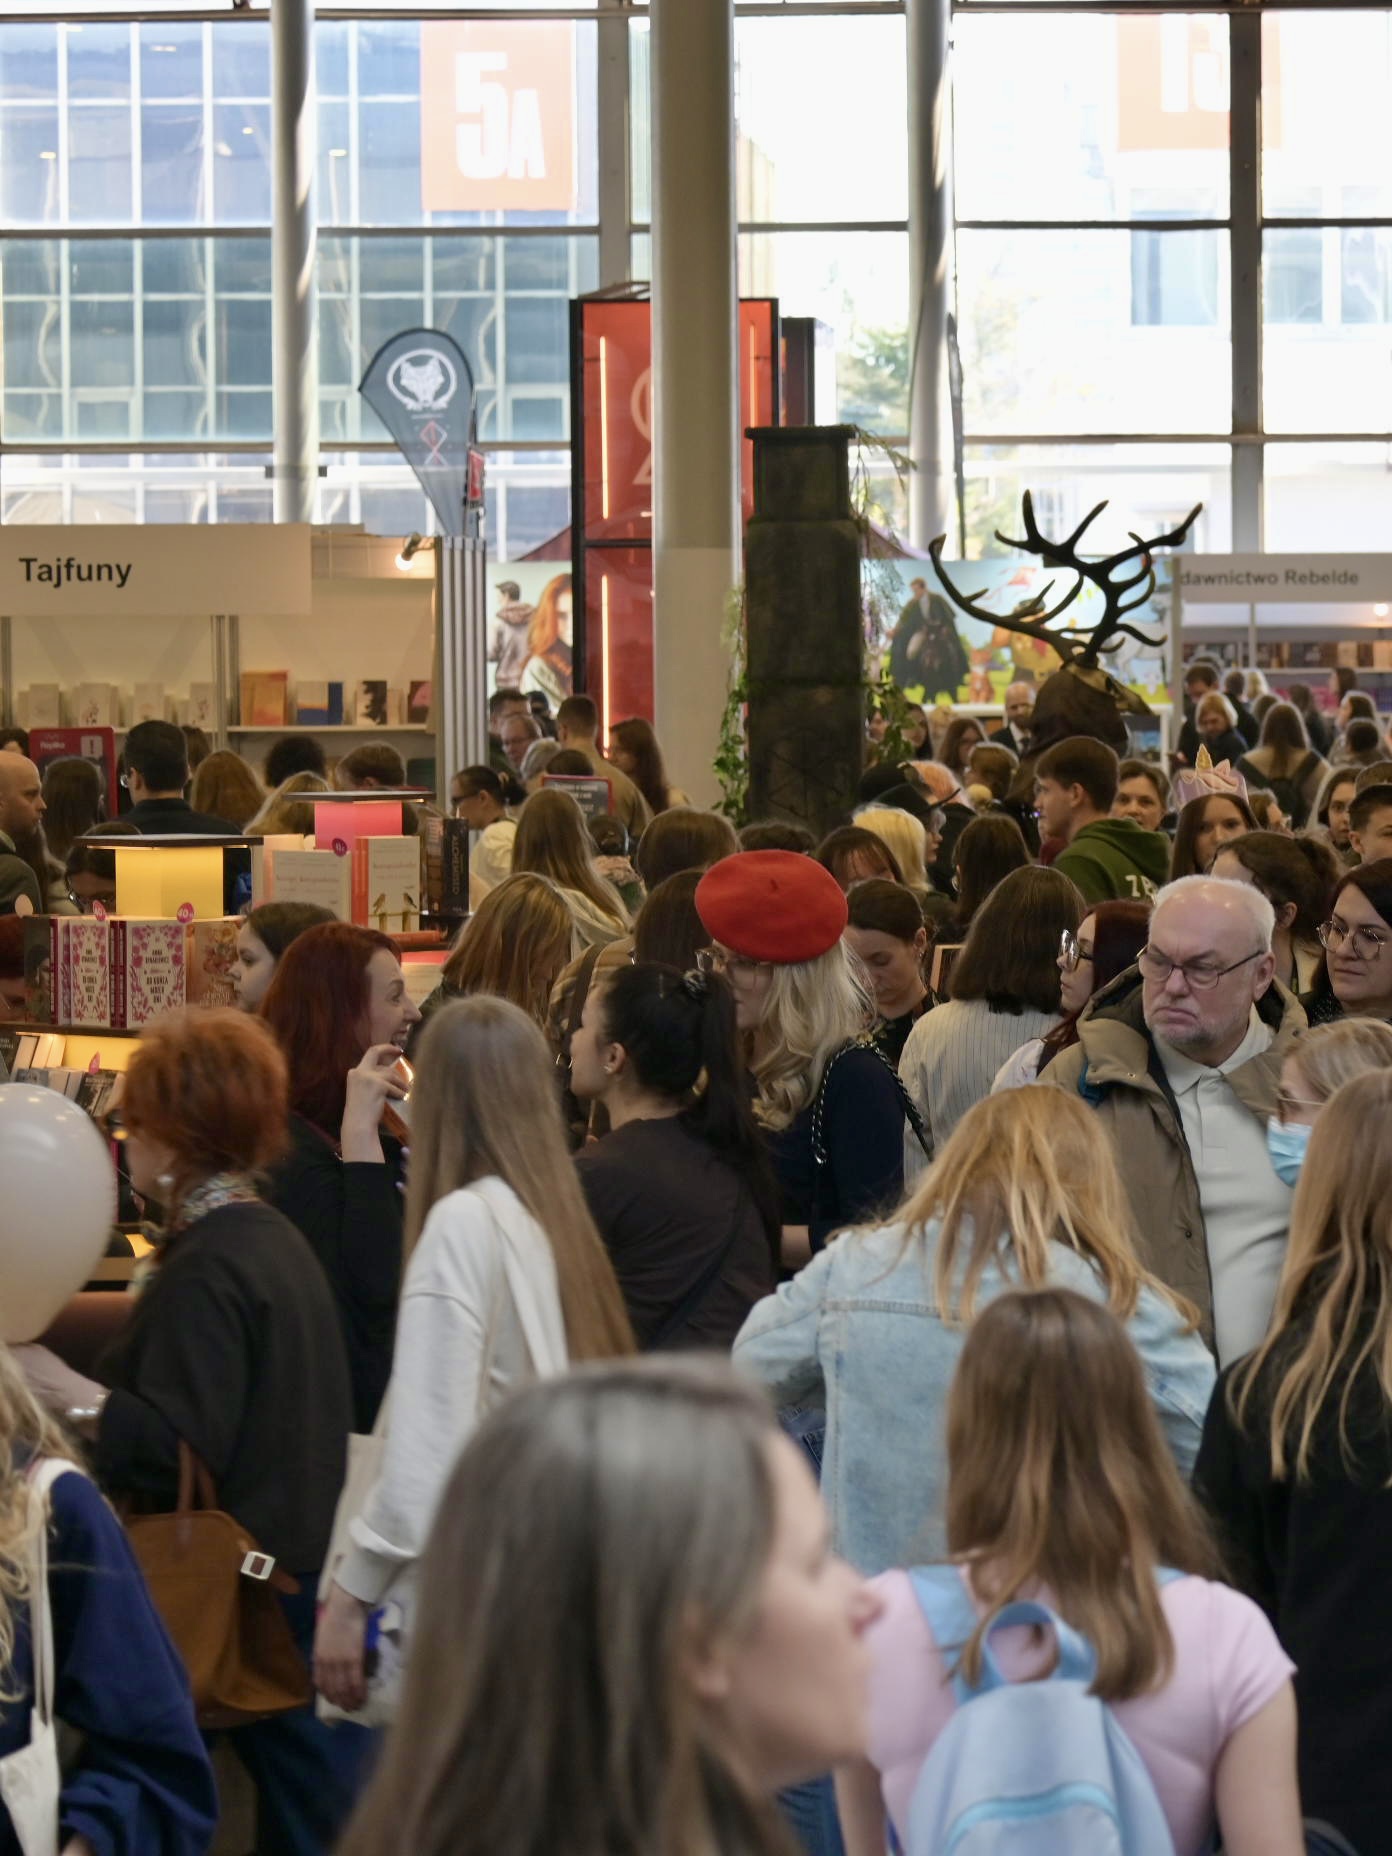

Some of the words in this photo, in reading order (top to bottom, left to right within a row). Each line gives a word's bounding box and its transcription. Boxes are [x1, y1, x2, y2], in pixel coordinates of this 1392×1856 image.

[456, 51, 546, 180] 5A
[18, 557, 132, 588] Tajfuny
[1284, 569, 1359, 585] Rebelde
